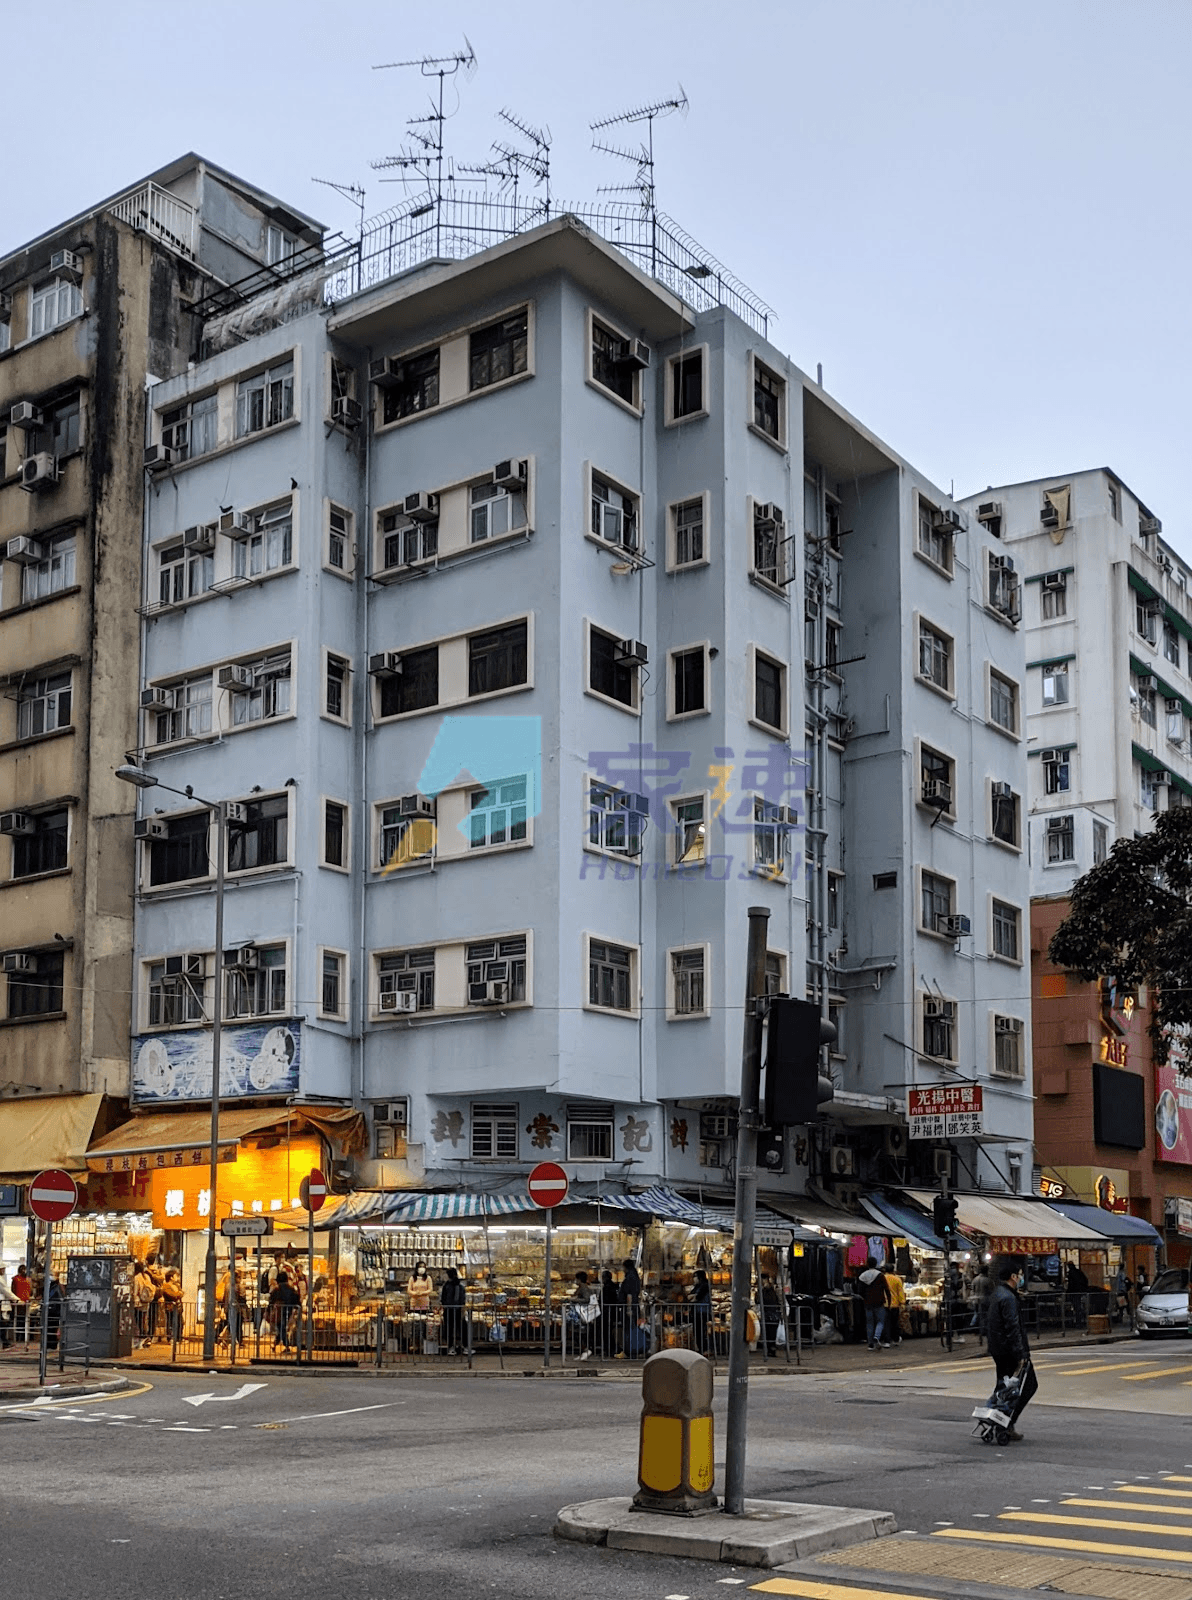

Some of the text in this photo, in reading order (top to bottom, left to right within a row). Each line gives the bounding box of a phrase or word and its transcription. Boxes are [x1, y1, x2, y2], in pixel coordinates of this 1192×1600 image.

[917, 1088, 974, 1106] 光揚中醫
[911, 1123, 944, 1137] 尹福標
[948, 1121, 982, 1135] 鄧笑英
